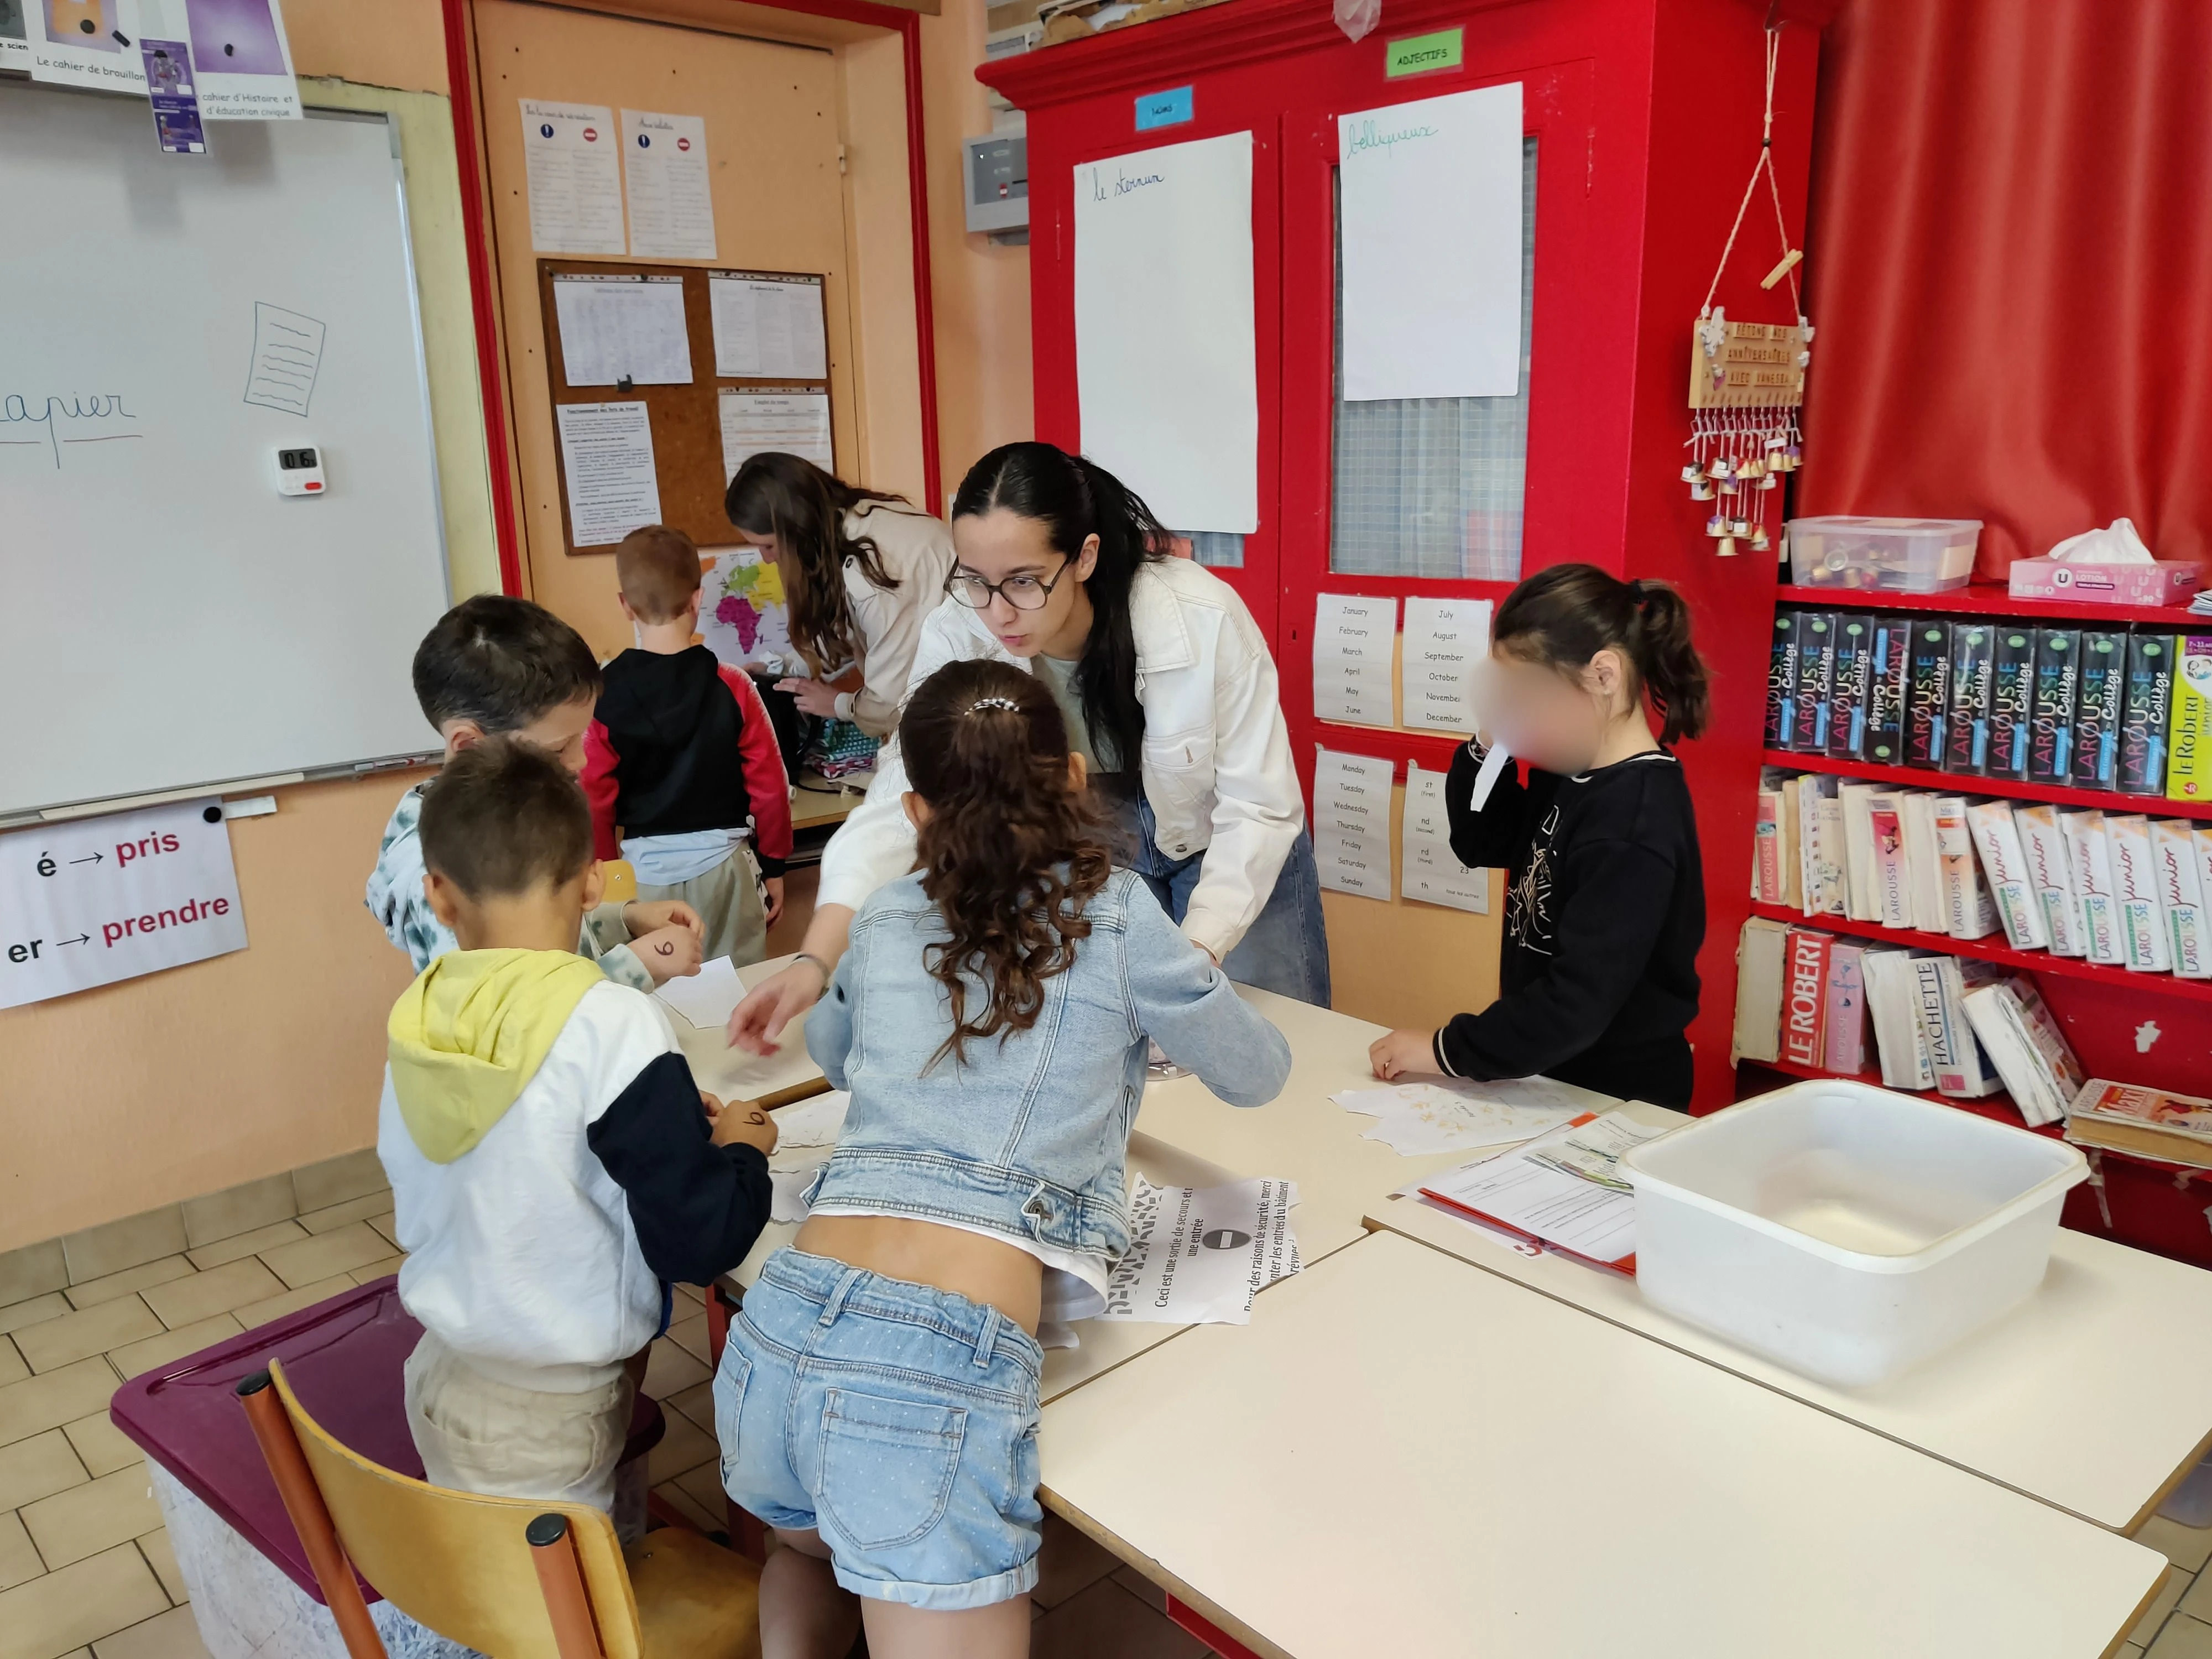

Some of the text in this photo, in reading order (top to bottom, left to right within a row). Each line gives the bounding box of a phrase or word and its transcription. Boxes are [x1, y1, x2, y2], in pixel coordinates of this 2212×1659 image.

[37, 56, 145, 82] Le cahier de brouillon
[1397, 48, 1448, 66] ADJECTIFS
[203, 92, 293, 104] cahier d'Histoire et
[1347, 120, 1438, 159] belliqueux
[1093, 168, 1107, 201] le
[0, 391, 137, 469] apier
[1339, 626, 1368, 638] February
[1342, 606, 1368, 618] January
[1438, 610, 1454, 620] July
[1342, 646, 1363, 656] March
[1424, 651, 1464, 662] September
[1432, 632, 1457, 642] August
[1344, 667, 1360, 676] April
[1428, 672, 1458, 682] October
[1782, 643, 1797, 688] Collège
[1817, 646, 1833, 692] Collège
[1852, 649, 1868, 697] Collège
[1883, 628, 1907, 733] LAROUSSE
[1932, 656, 1950, 705] Collège
[1974, 659, 1991, 709] Collège
[2015, 662, 2032, 713] Collège
[1345, 687, 1359, 697] May
[1345, 706, 1361, 714] June
[1765, 643, 1783, 742] LAROUSSE
[1797, 646, 1819, 745] LAROUSSE
[1832, 649, 1853, 751] LAROUSSE
[1869, 685, 1886, 732] Collège
[1912, 656, 1934, 761] LAROUSSE
[1952, 659, 1975, 766] LAROUSSE
[2057, 665, 2075, 717] Collège
[2102, 668, 2121, 721] Collège
[2150, 671, 2170, 724] Collège
[1426, 712, 1462, 723] December
[1992, 662, 2016, 771] LAROUSSE
[2034, 665, 2059, 776] LAROUSSE
[2078, 668, 2104, 780] LAROUSSE
[2125, 671, 2152, 786] LAROUSSE
[1339, 782, 1365, 795] Tuesday
[1342, 763, 1365, 775] Monday
[1333, 801, 1369, 815] Wednesday
[1337, 821, 1365, 834] Thursday
[37, 831, 180, 877] é pris
[1338, 857, 1366, 870] Saturday
[1341, 839, 1361, 851] Friday
[1421, 848, 1429, 856] rd
[1764, 838, 1774, 897] LAROUSSE
[1987, 830, 2023, 885] junior
[2031, 833, 2064, 890] junior
[2078, 838, 2111, 896] junior
[1340, 876, 1363, 888] Sunday
[1421, 881, 1429, 889] th
[1887, 860, 1901, 921] LAROUSSE
[2117, 843, 2153, 902] junior
[2163, 847, 2199, 908] junior
[1951, 870, 1964, 932] LAROUSSE
[2007, 885, 2032, 944] LAROUSSE
[2048, 891, 2070, 951] LAROUSSE
[8, 897, 229, 963] er prendre
[2093, 898, 2112, 959] LAROUSSE
[2134, 904, 2154, 967] LAROUSSE
[2179, 909, 2200, 972] LAROUSSE
[1788, 936, 1823, 1065] LE ROBERT
[1918, 963, 1950, 1065] HACHETTE
[1176, 1198, 1190, 1225] secours
[1260, 1180, 1272, 1199] merci
[1171, 1227, 1185, 1237] de
[1187, 1218, 1204, 1256] une entrée
[1253, 1229, 1266, 1239] de
[1254, 1200, 1271, 1230] sécurité,
[1269, 1181, 1290, 1281] nter les entrées du bâtiment
[1165, 1259, 1177, 1272] une
[1169, 1238, 1182, 1258] sortie
[1250, 1240, 1265, 1269] raisons
[1155, 1288, 1170, 1307] Ceci
[1162, 1273, 1173, 1286] est
[1247, 1270, 1261, 1287] des
